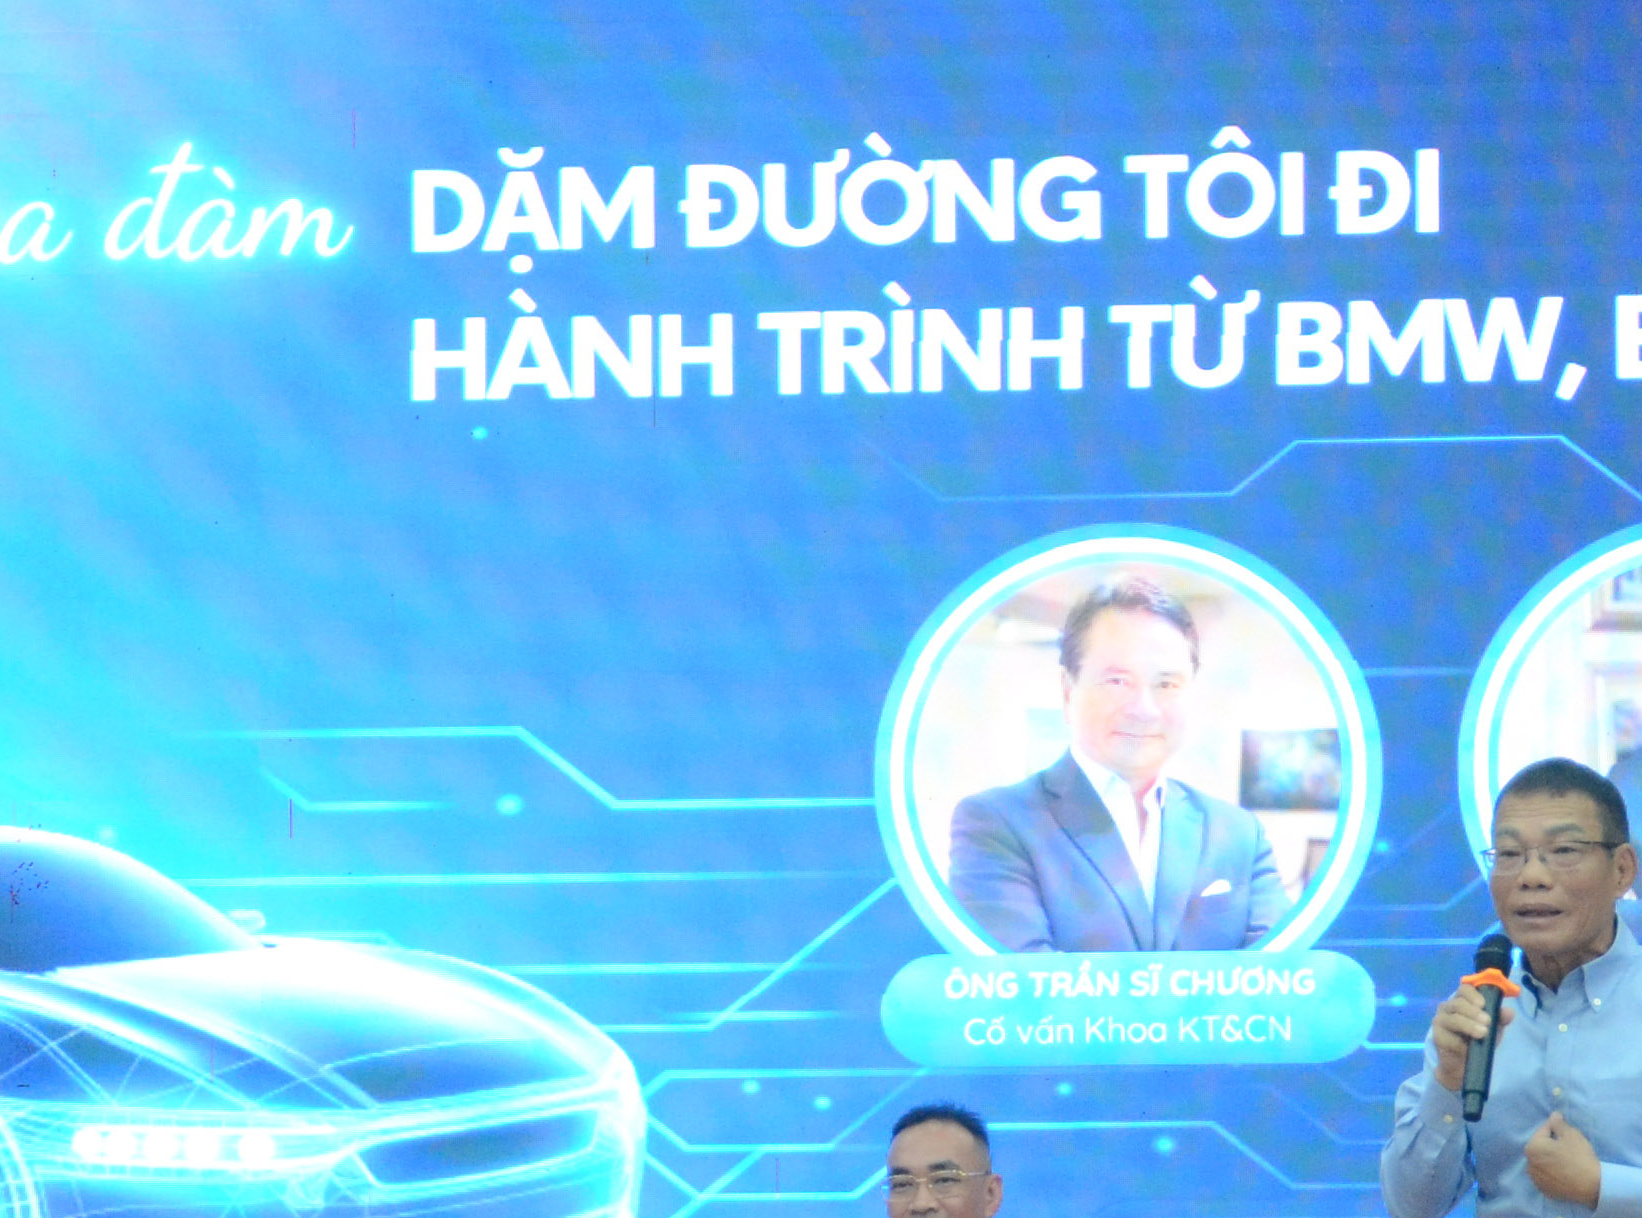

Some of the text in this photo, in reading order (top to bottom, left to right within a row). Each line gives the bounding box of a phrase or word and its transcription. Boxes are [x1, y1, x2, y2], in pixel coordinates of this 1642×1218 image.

[104, 141, 355, 262] đàm
[412, 125, 1441, 273] DẶM ĐƯỜNG TÔI ĐI
[412, 288, 733, 401] HÀNH
[759, 281, 1085, 395] TRÌNH
[1111, 274, 1260, 390] TỪ
[1277, 294, 1587, 400] BMW,
[944, 966, 1019, 999] ÔNG
[1169, 965, 1316, 997] CHƯƠNG
[964, 1014, 1292, 1045] Cố vấn Khoa KT&CN
